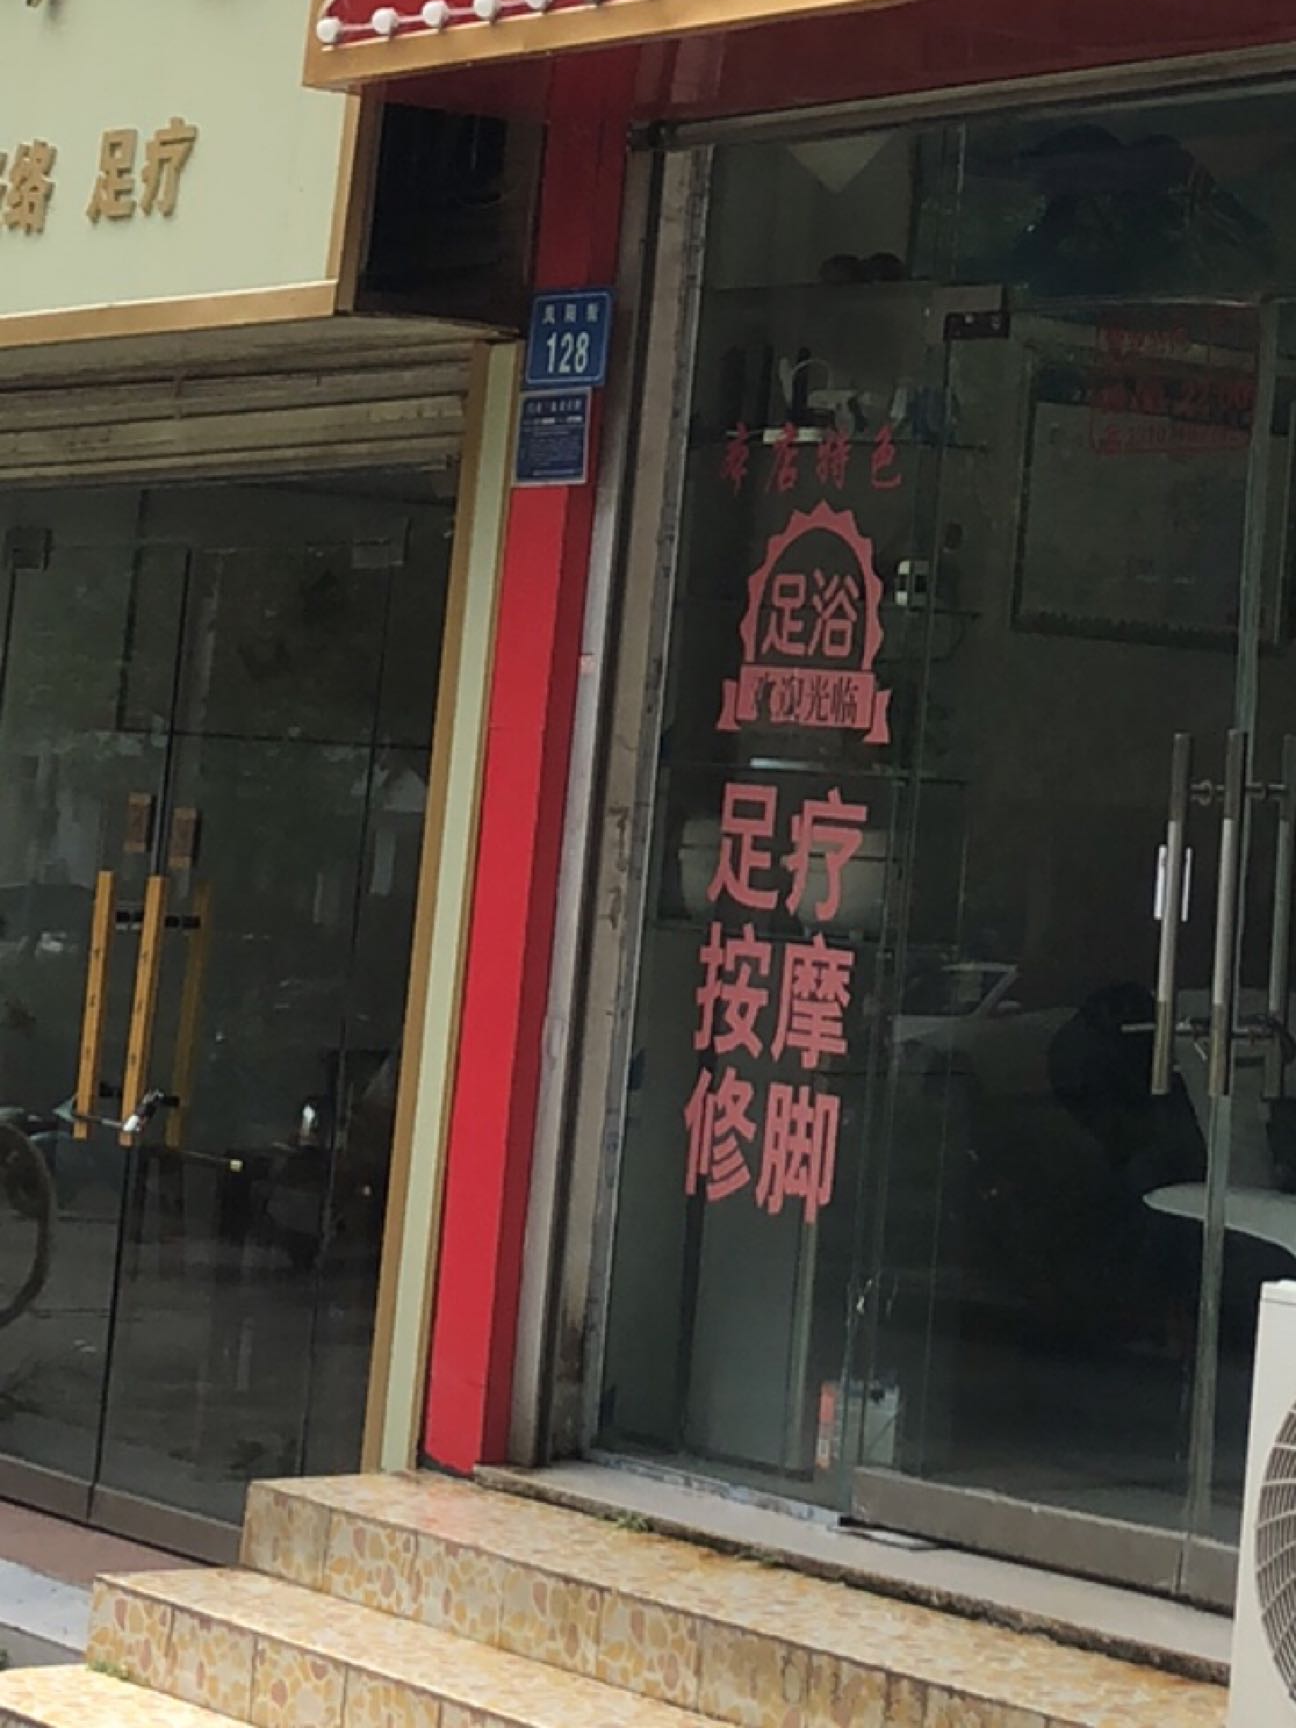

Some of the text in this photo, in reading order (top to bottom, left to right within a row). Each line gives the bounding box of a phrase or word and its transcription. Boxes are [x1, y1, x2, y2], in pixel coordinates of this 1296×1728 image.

[0, 116, 198, 236] 络 足疗
[546, 330, 591, 374] 128
[761, 568, 859, 658] 足浴
[707, 782, 869, 922] 足疗
[694, 921, 856, 1070] 按摩
[684, 1066, 842, 1225] 修脚
